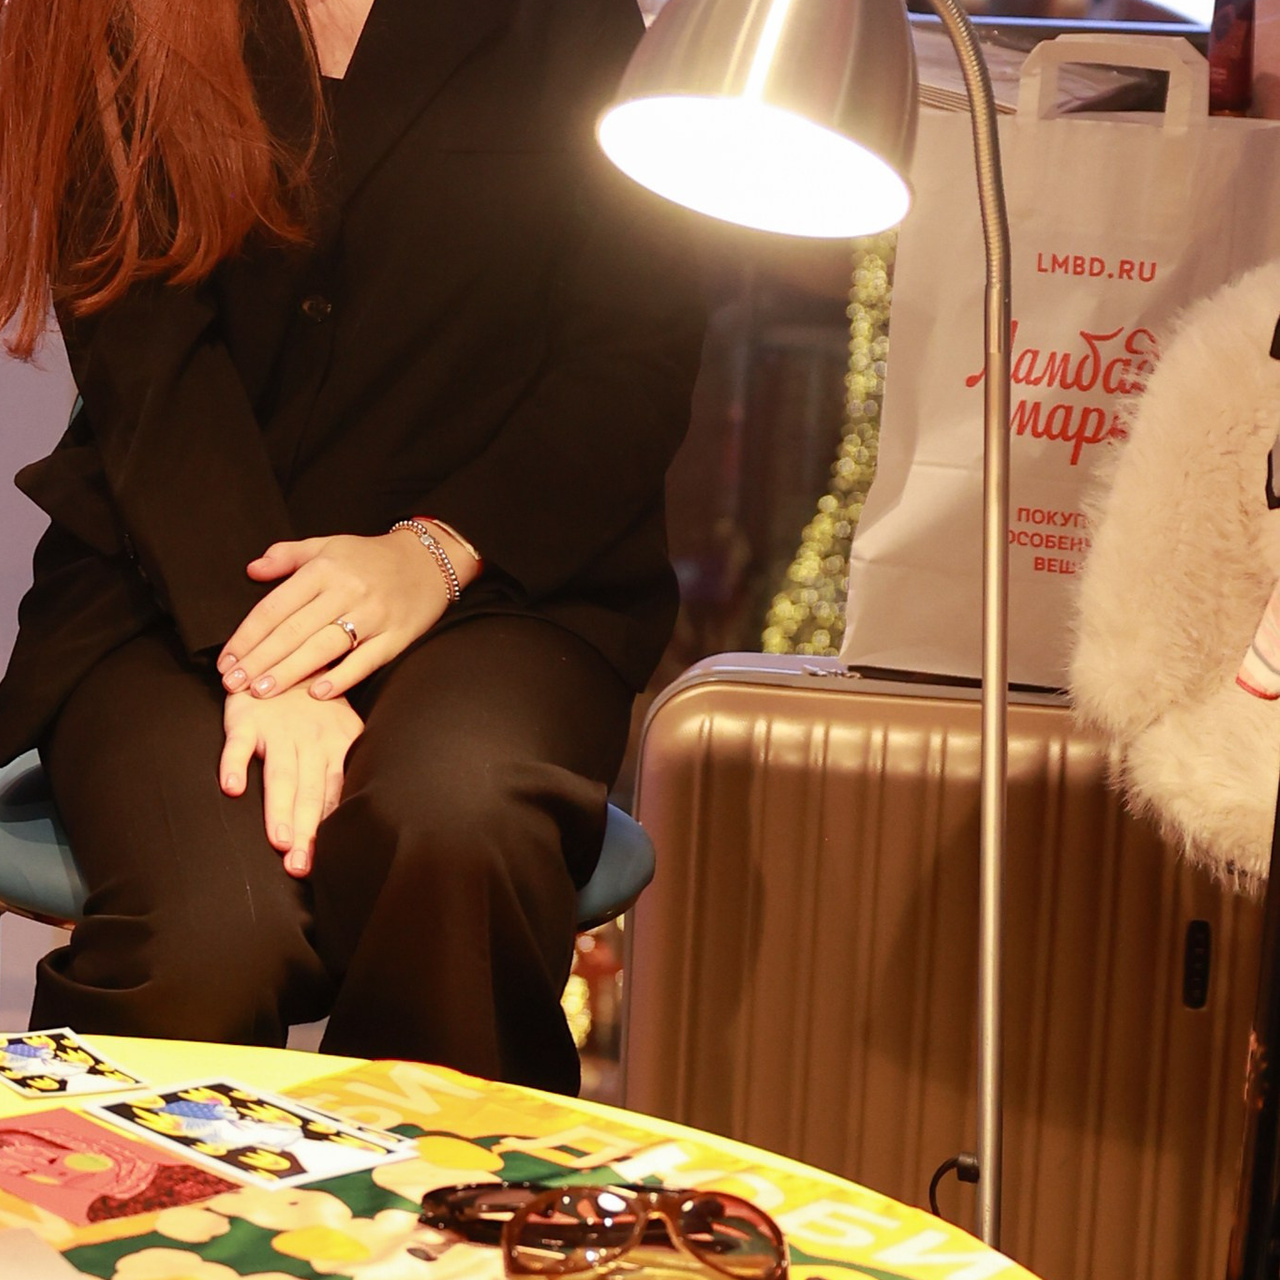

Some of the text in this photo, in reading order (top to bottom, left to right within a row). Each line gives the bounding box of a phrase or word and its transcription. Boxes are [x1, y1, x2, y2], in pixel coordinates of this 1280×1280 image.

[1037, 252, 1158, 283] LMBD.RU
[1017, 507, 1088, 529] ПОКУП
[1009, 530, 1092, 552] СОБЕН
